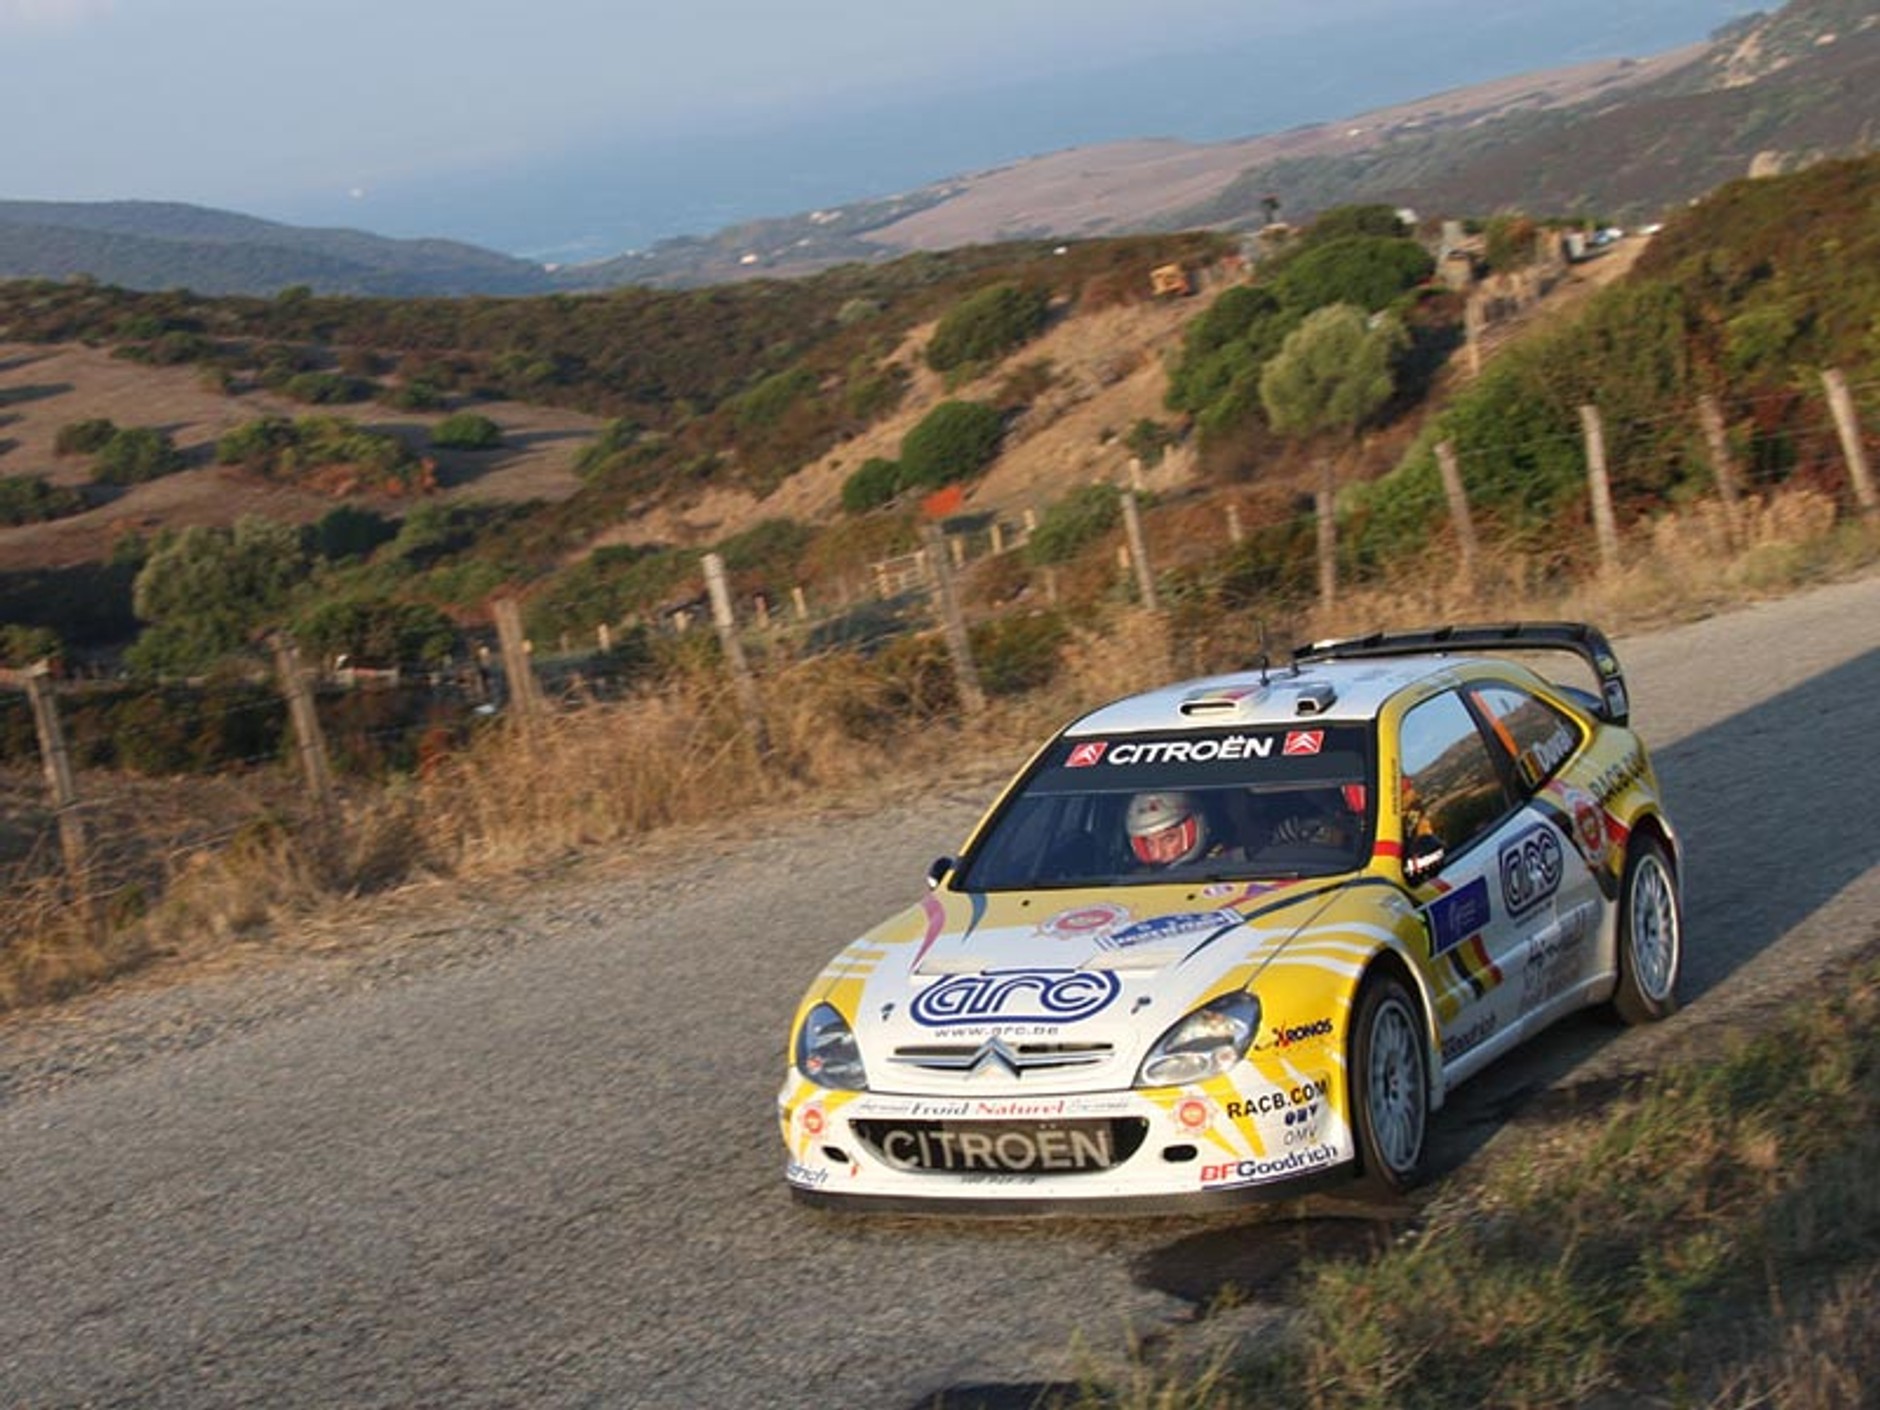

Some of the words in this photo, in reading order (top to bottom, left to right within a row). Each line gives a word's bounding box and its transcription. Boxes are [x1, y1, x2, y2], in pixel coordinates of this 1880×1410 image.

[1107, 735, 1274, 765] CITROËN
[912, 971, 1117, 1024] arc
[1226, 1079, 1327, 1119] RACB.COM
[883, 1123, 1111, 1169] CITROËN
[1200, 1144, 1339, 1182] BFGoodrich
